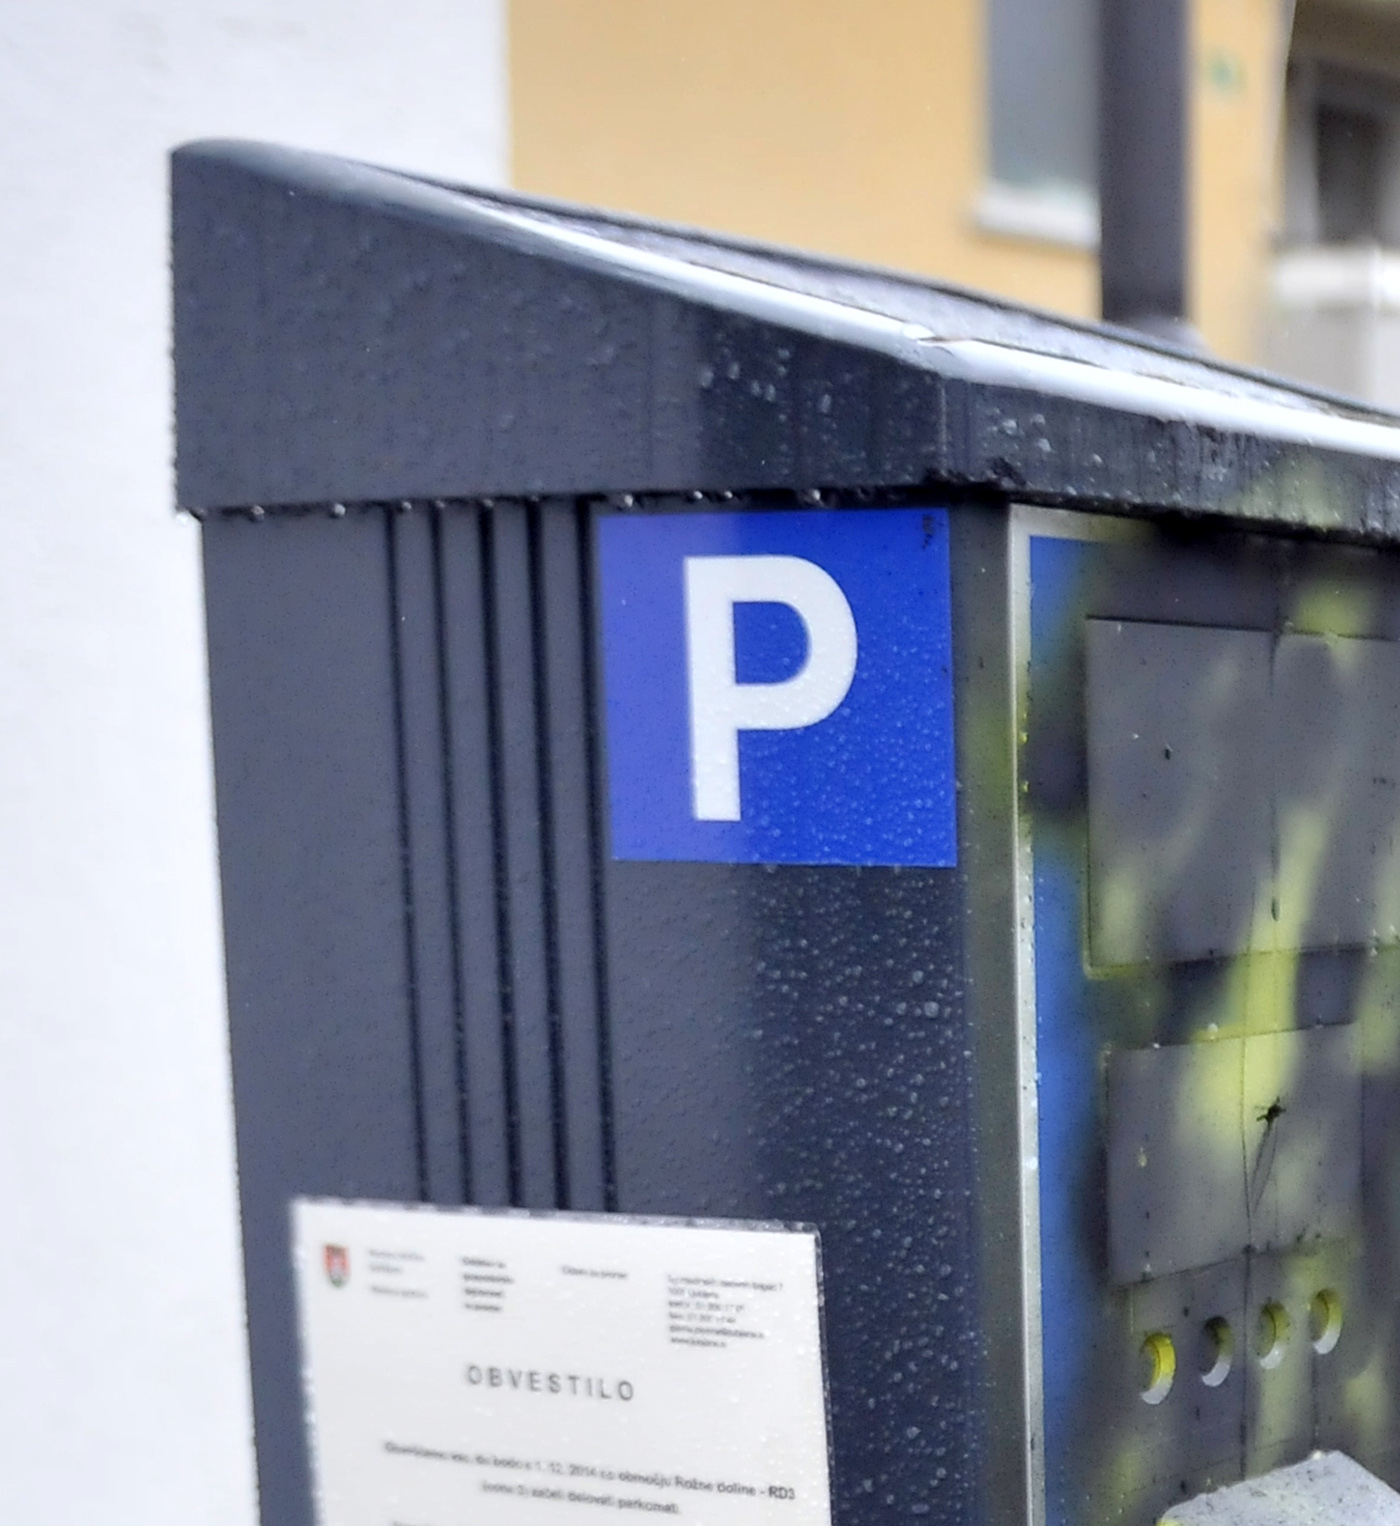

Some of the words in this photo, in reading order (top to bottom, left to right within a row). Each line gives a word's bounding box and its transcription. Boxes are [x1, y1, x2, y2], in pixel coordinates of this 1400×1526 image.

[682, 554, 859, 822] P
[467, 1365, 635, 1401] OBVESTILO
[618, 1470, 672, 1490] območju
[674, 1475, 714, 1493] Rožne
[717, 1480, 756, 1497] doline
[768, 1485, 796, 1501] RD3
